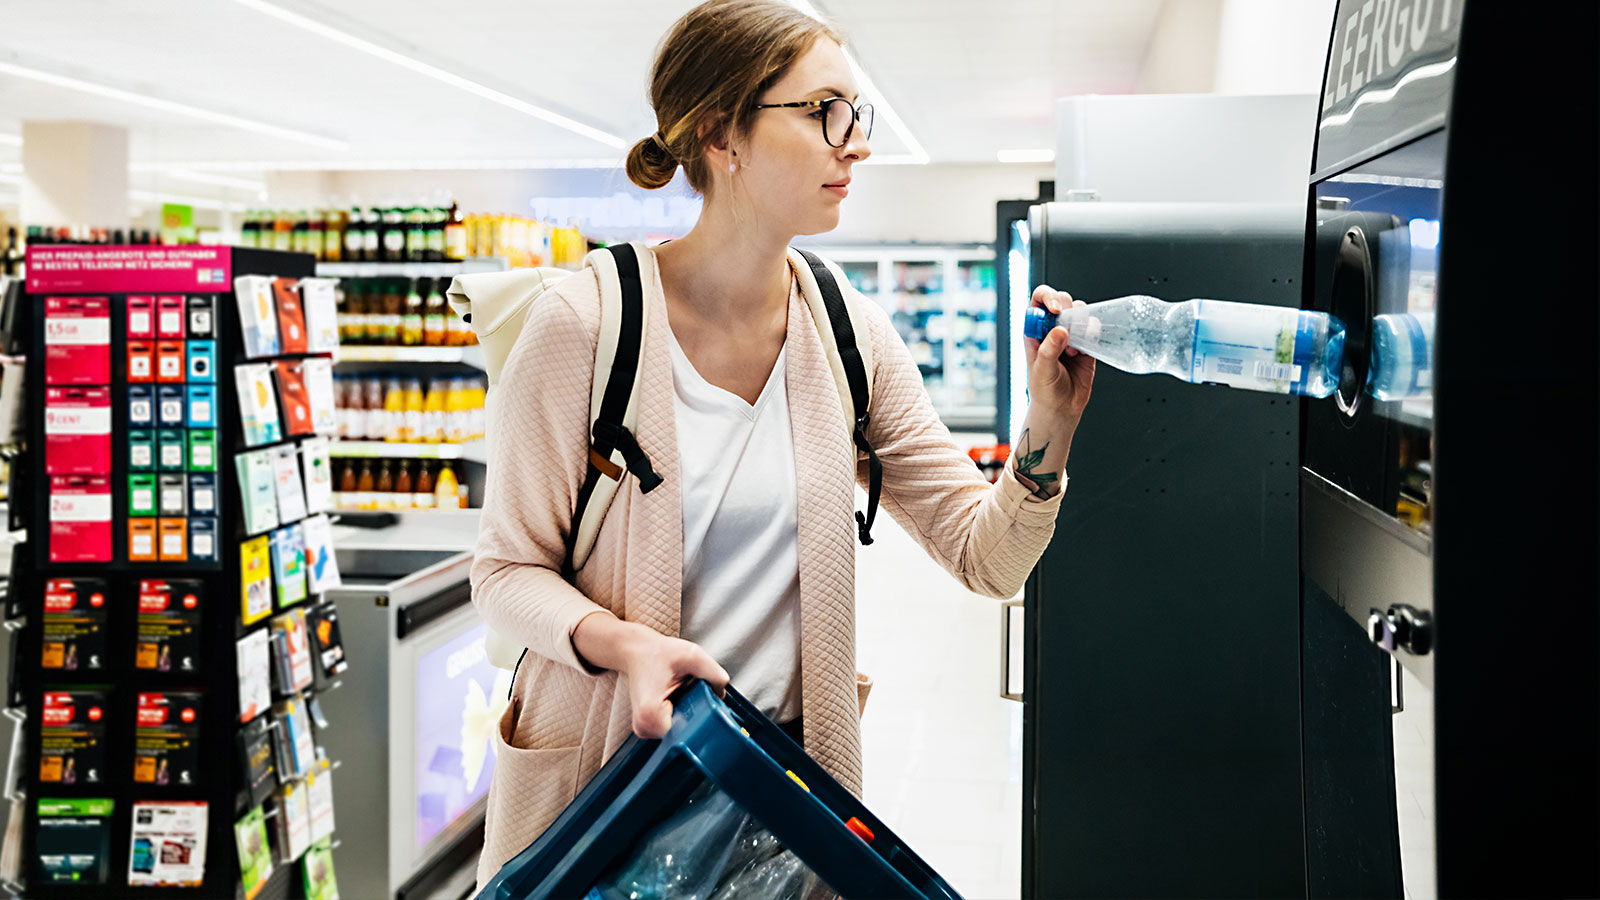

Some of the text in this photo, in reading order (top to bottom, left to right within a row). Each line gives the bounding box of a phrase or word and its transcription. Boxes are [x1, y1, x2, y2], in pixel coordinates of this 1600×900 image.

[32, 250, 217, 260] HIER PREPAID-ANGEBOTE UND GUTHABEN
[32, 261, 43, 270] IM
[45, 261, 79, 270] BESTEN
[82, 261, 123, 270] TELEKOM
[125, 260, 148, 269] NETZ
[47, 412, 81, 424] 9 CENT
[52, 499, 59, 512] 2
